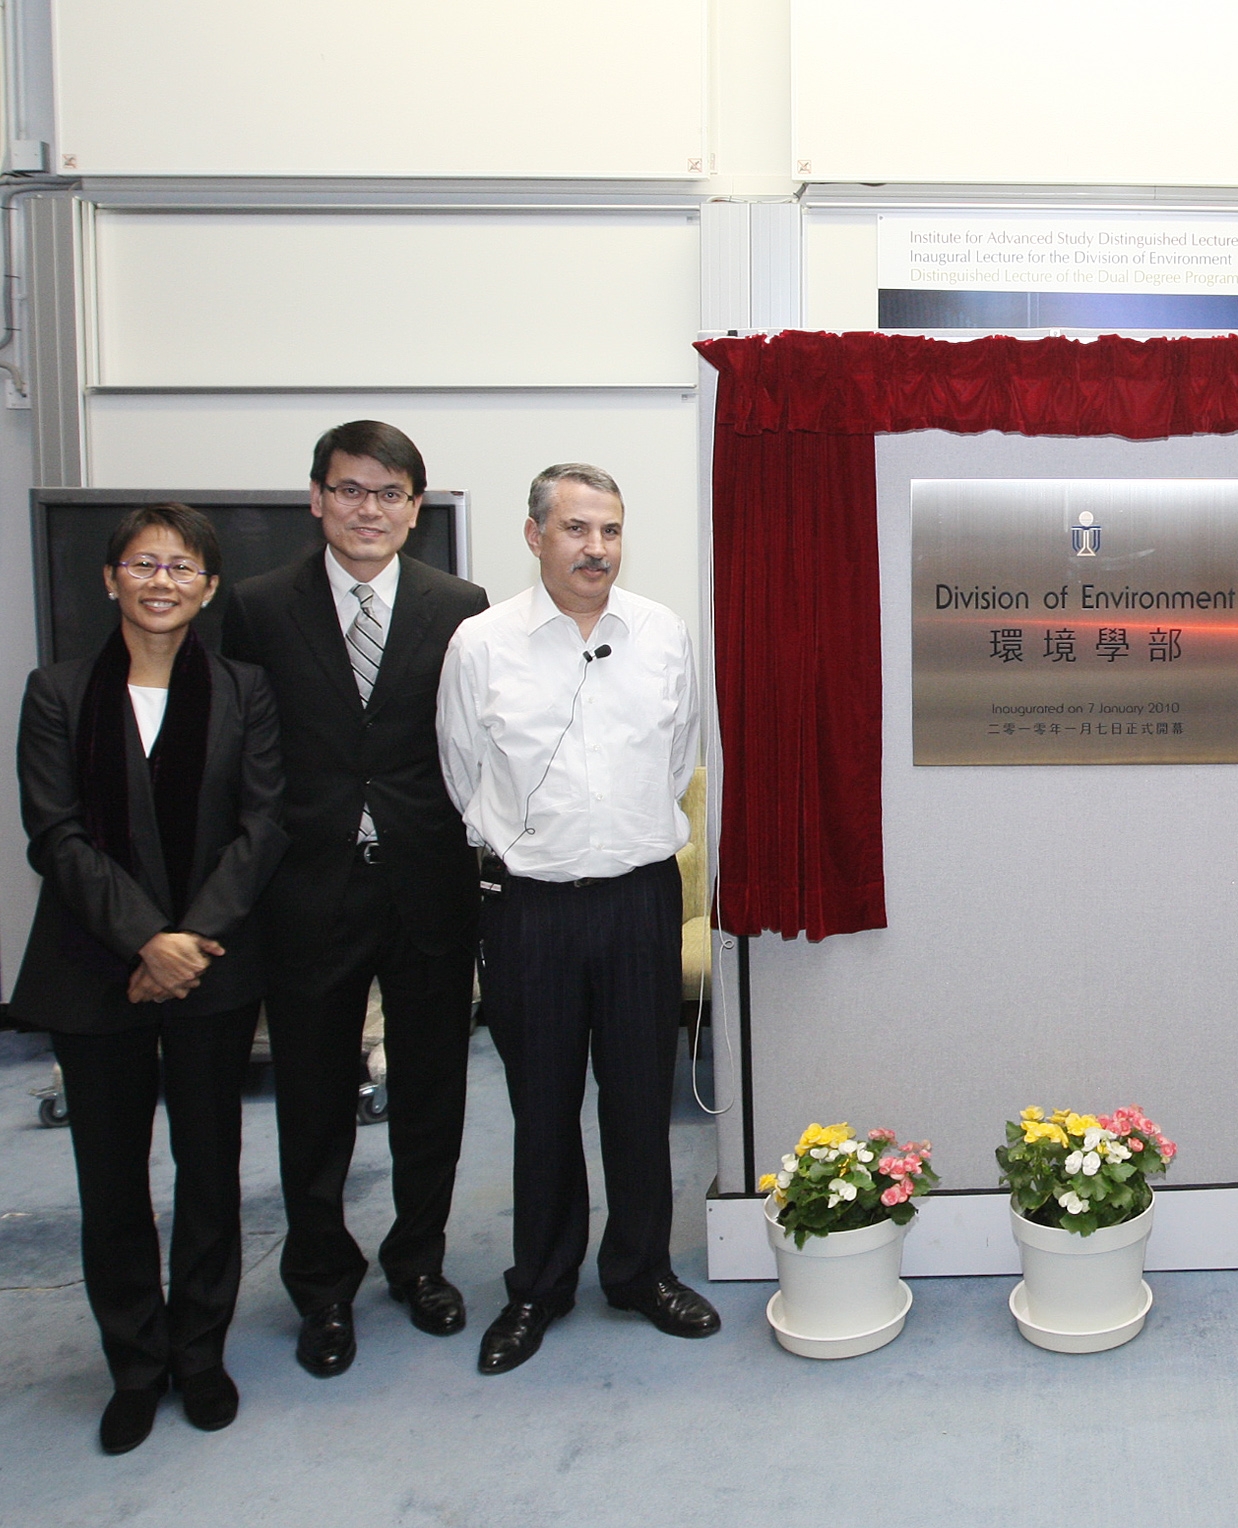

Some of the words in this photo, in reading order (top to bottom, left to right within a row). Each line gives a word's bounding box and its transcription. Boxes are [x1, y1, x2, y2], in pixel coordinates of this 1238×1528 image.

[909, 230, 962, 245] Institute
[965, 230, 984, 245] for
[987, 231, 1053, 245] Advanced
[1057, 231, 1094, 248] Study
[1098, 232, 1187, 249] Distinguished
[1191, 233, 1238, 247] Lecture
[909, 249, 971, 266] Inaugural
[976, 250, 1024, 264] Lecture
[1027, 249, 1046, 264] for
[1049, 250, 1070, 264] the
[1074, 250, 1129, 264] Division
[1132, 250, 1146, 265] of
[1150, 251, 1232, 266] Environment
[910, 268, 1000, 284] Distinguished
[1004, 269, 1052, 283] Lecture
[1056, 269, 1070, 283] of
[1073, 269, 1094, 283] the
[1098, 269, 1129, 284] Dual
[1134, 270, 1181, 286] Degree
[1185, 271, 1238, 287] Program
[935, 583, 1029, 610] Division
[1043, 585, 1069, 610] of
[1081, 583, 1236, 610] Environment
[989, 626, 1182, 663] 環境學部
[991, 702, 1065, 717] Inaugurated
[1067, 704, 1084, 714] on
[1088, 702, 1096, 714] 7
[1099, 702, 1144, 717] January
[1148, 702, 1180, 714] 2010
[987, 722, 1184, 735] 二零一零年一月七日正式開幕
